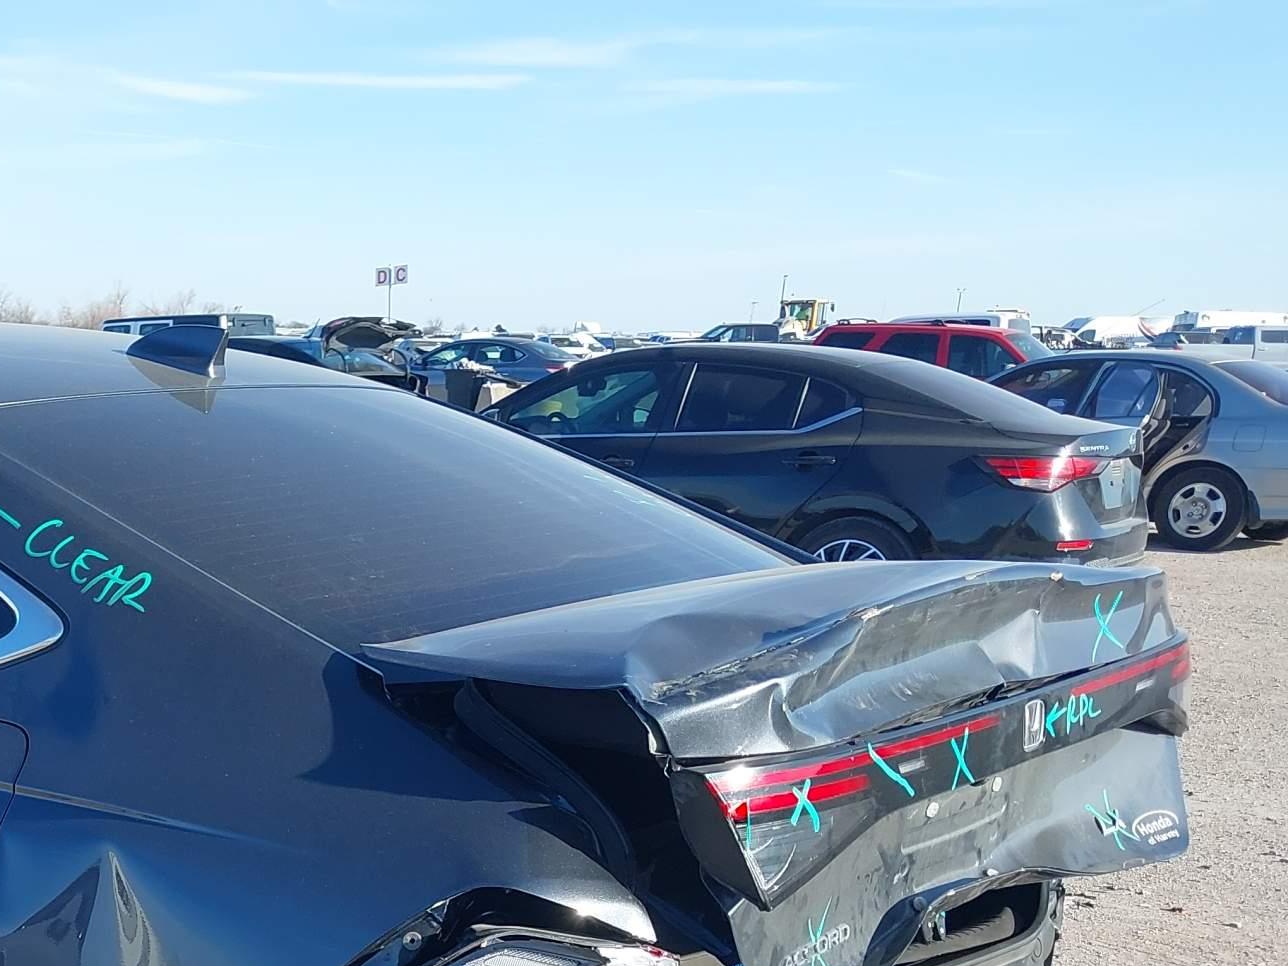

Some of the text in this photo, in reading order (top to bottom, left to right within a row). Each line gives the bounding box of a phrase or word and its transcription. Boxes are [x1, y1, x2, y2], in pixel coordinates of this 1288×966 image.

[377, 267, 406, 284] D C
[24, 518, 153, 613] CLEAR
[1066, 693, 1102, 735] RPL
[1136, 815, 1174, 837] Honda
